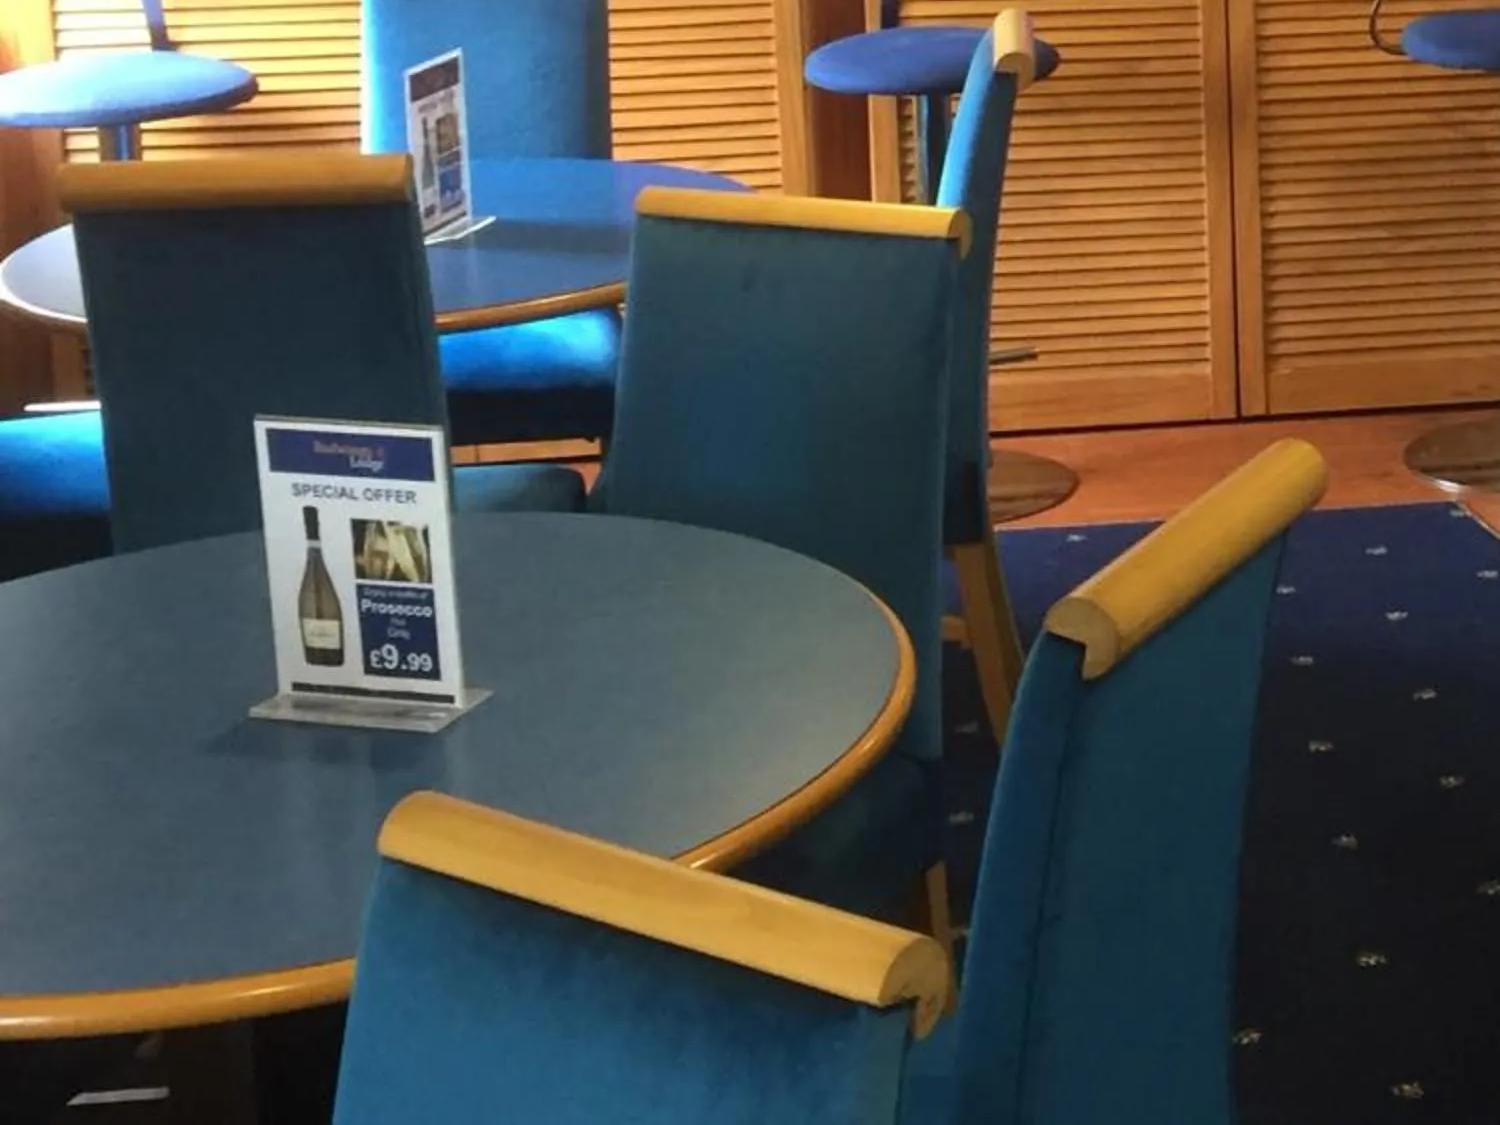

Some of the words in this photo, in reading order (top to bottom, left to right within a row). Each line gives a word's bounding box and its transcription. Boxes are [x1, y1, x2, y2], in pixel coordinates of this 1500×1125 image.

[291, 482, 359, 501] SPECIAL
[362, 487, 418, 505] OFFER
[360, 598, 434, 618] Prosecco
[369, 643, 434, 673] £9.99
